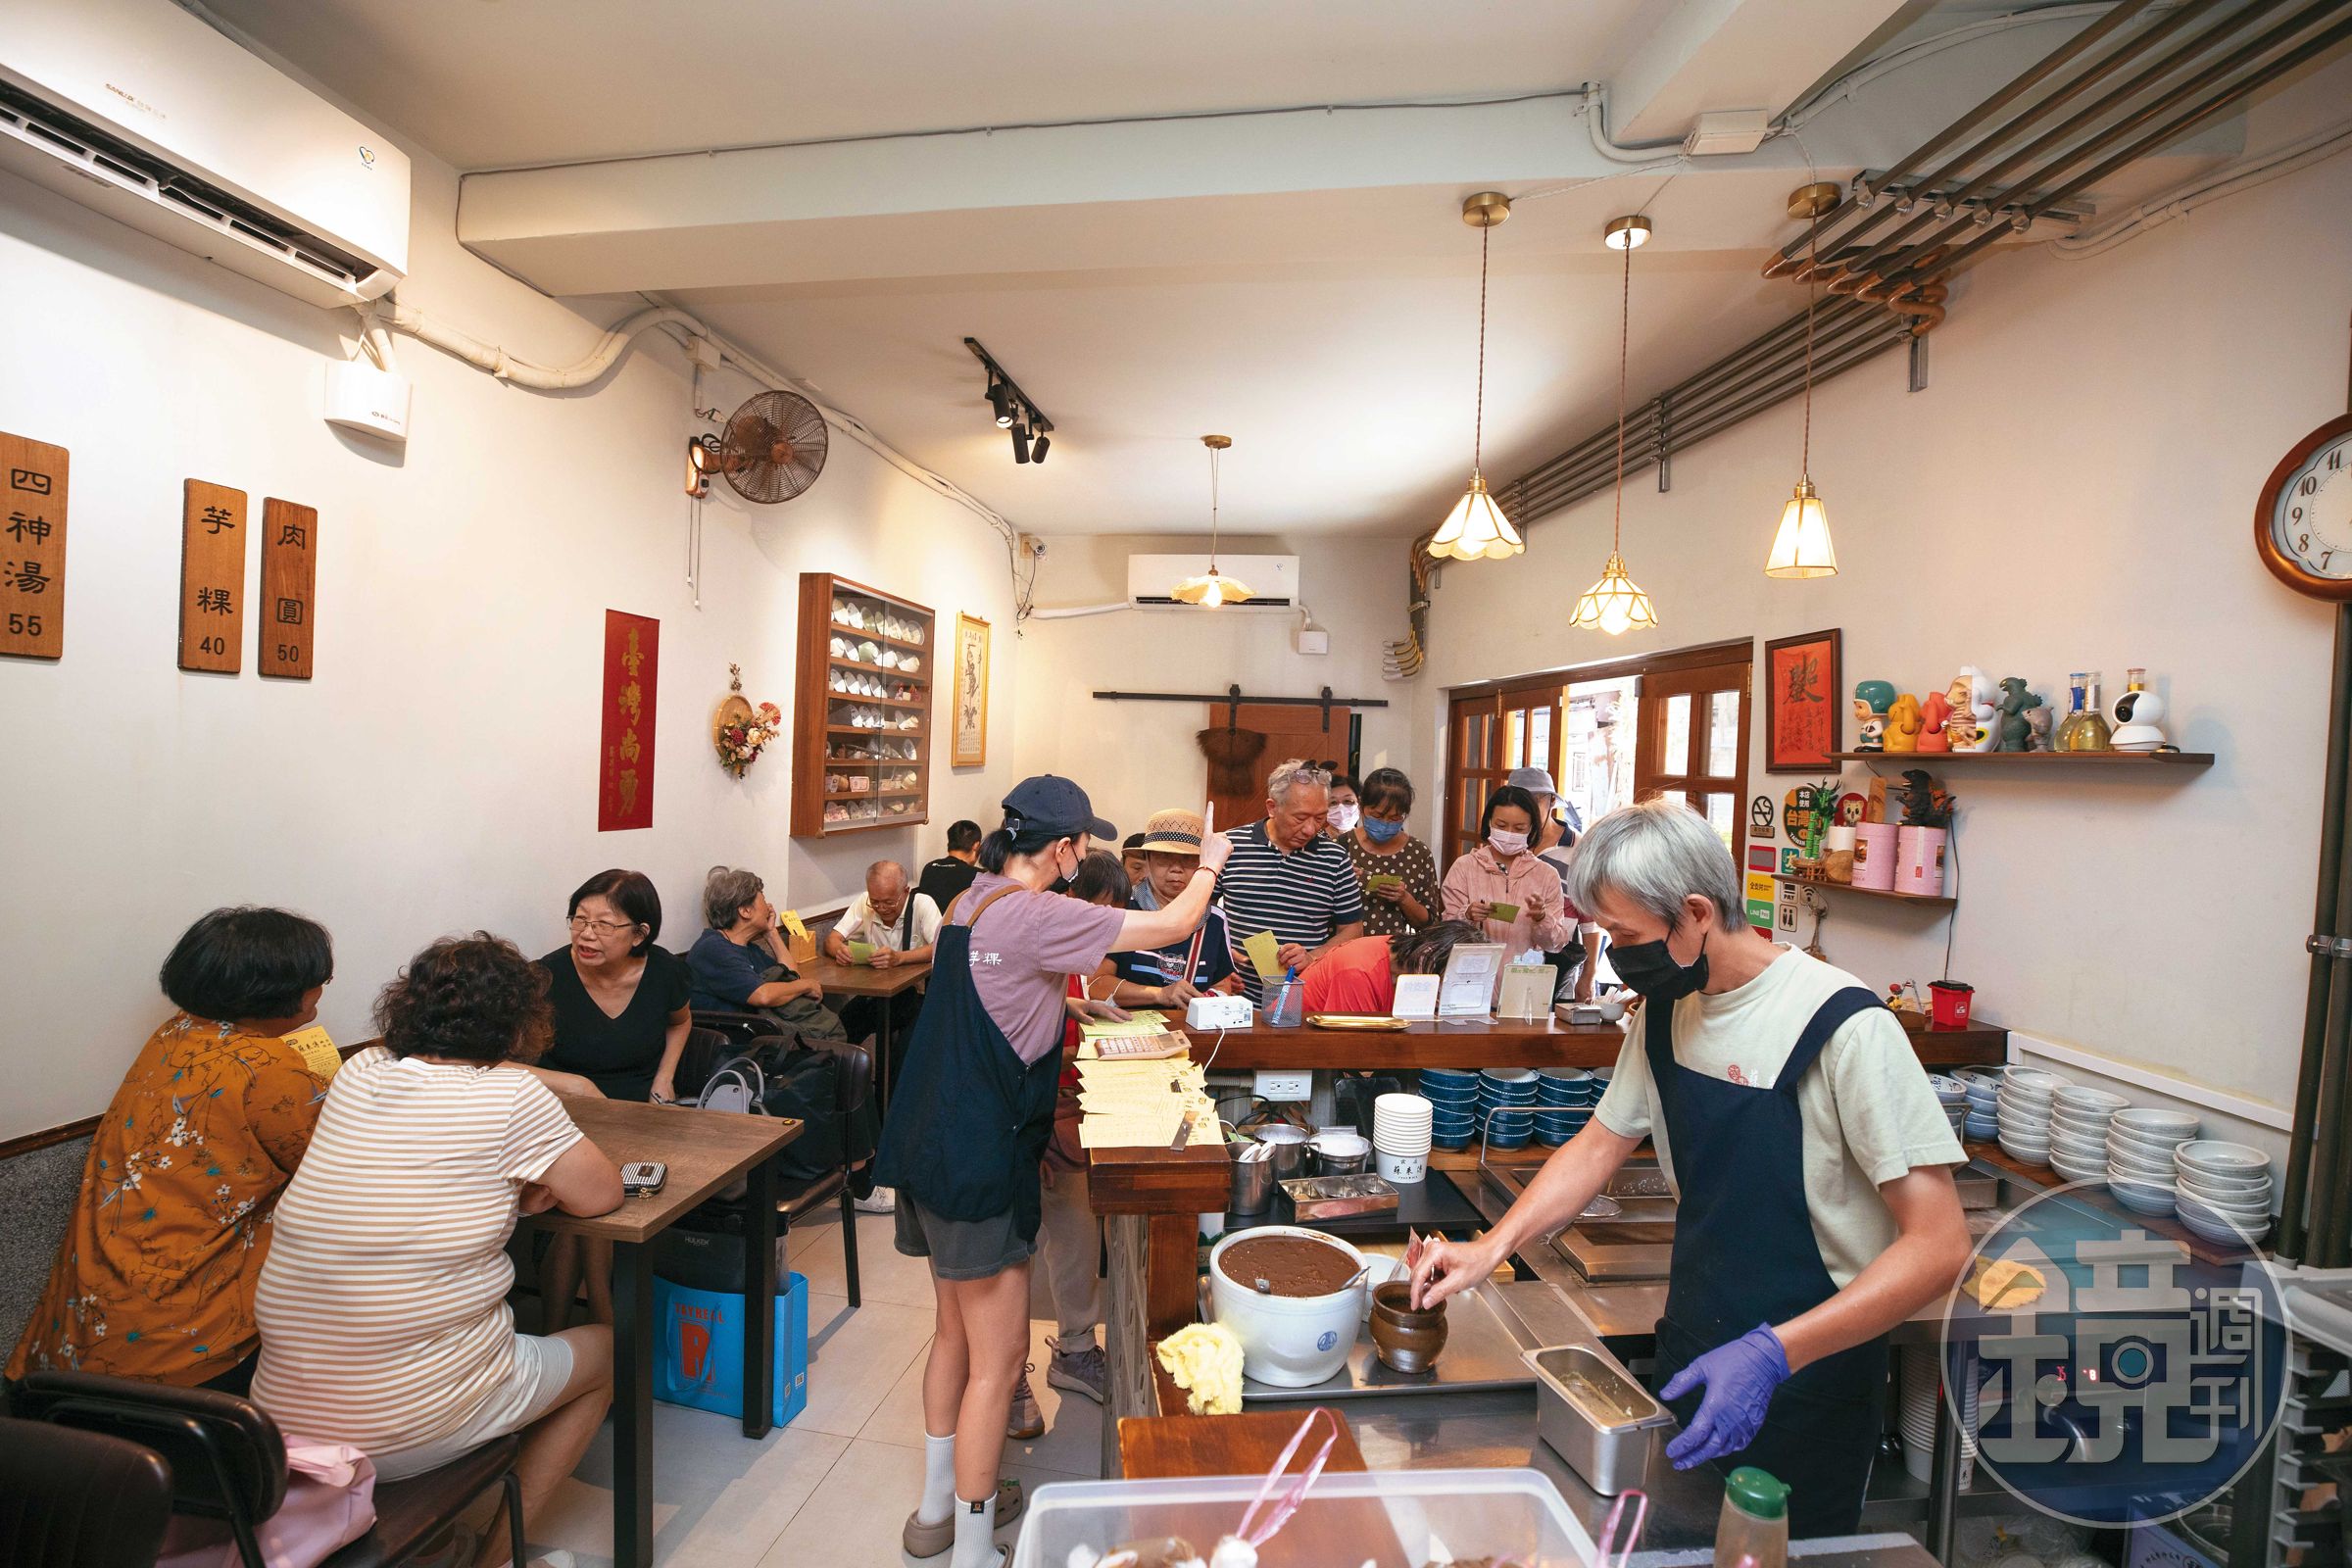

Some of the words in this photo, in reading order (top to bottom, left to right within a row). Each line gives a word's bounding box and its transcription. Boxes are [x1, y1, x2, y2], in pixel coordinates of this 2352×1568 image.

[2327, 449, 2342, 470] 11
[2298, 475, 2318, 497] 10
[2291, 507, 2303, 525] 9
[4, 467, 52, 594] 四神湯
[2298, 533, 2310, 552] 8
[197, 506, 236, 616] 芋粿
[2321, 551, 2333, 570] 7
[276, 523, 307, 625] 肉圓
[8, 612, 42, 637] 55
[199, 636, 225, 656] 40
[276, 644, 299, 662] 50
[969, 950, 1003, 967] 芋粿
